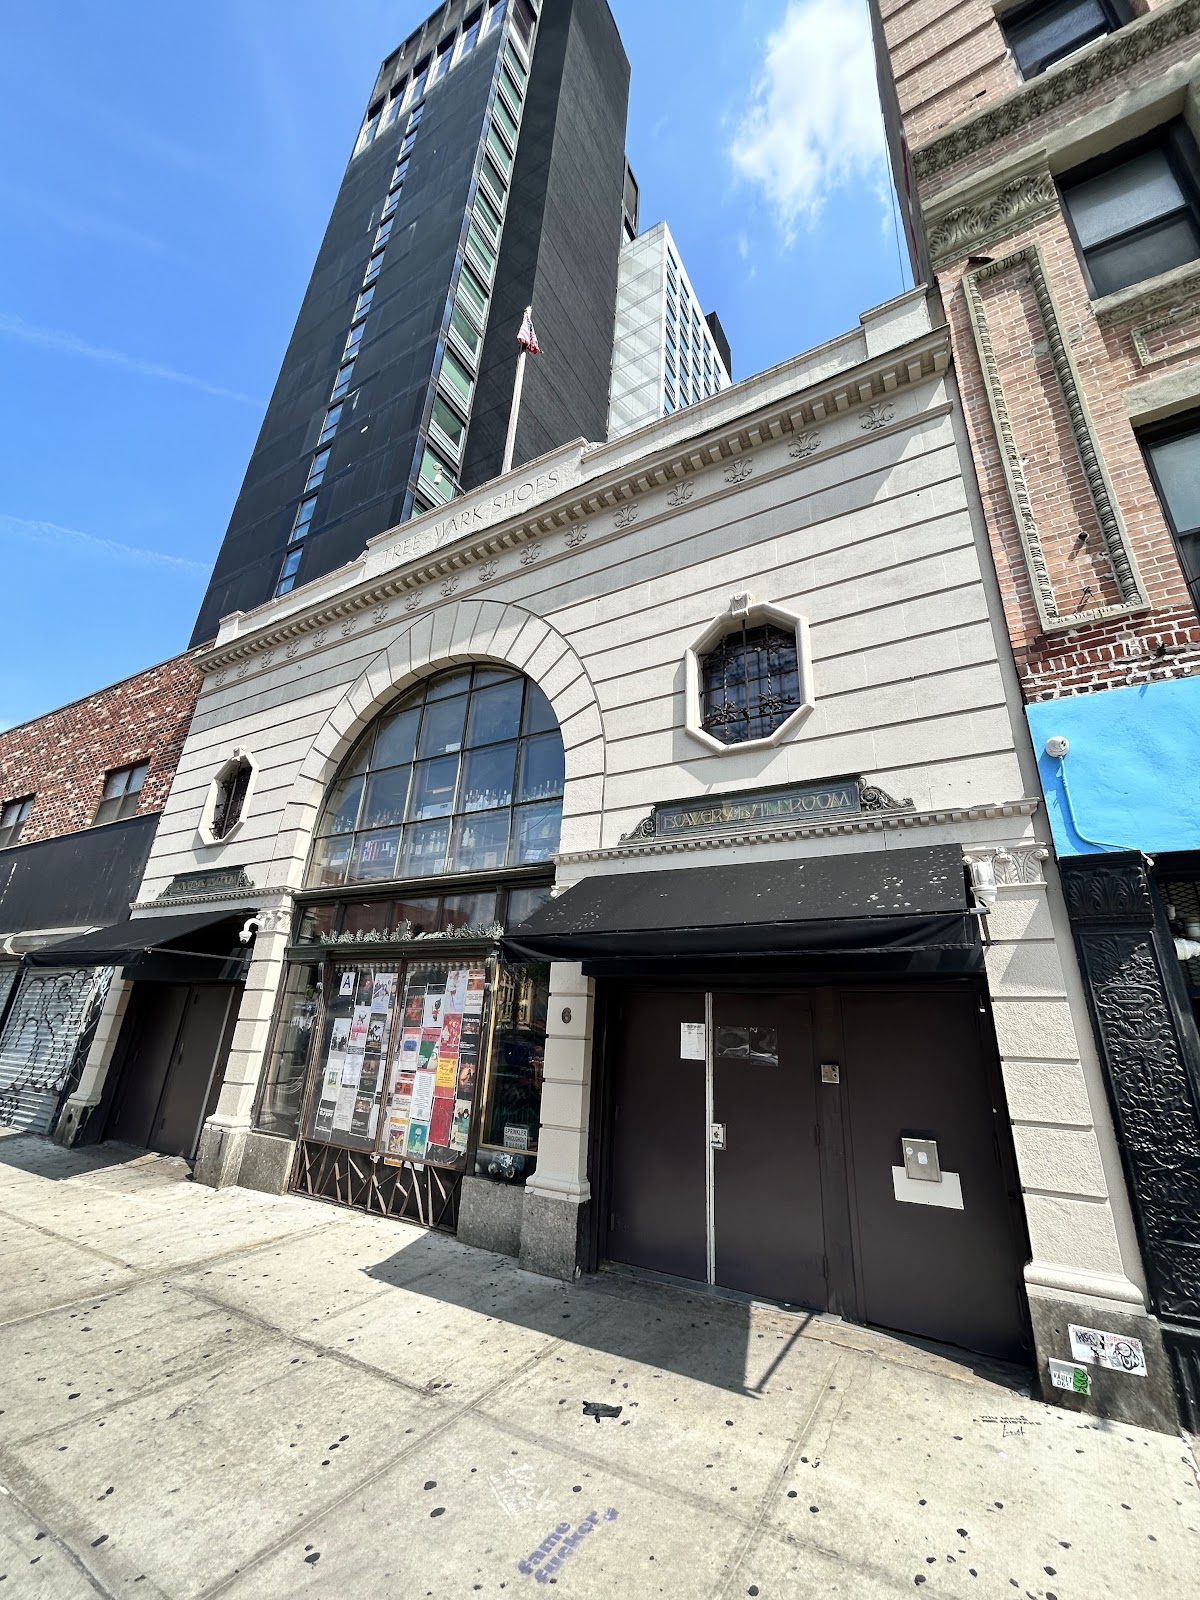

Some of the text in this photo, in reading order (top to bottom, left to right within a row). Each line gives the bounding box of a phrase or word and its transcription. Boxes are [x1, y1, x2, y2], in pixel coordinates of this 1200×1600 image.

[492, 470, 558, 514] SHOES
[663, 790, 851, 830] BOWERY BALLROOM
[342, 975, 351, 989] A
[561, 1007, 572, 1024] 6
[505, 1127, 527, 1137] SPRINKLER
[1053, 1371, 1073, 1384] VAULT
[517, 1522, 571, 1576] fame
